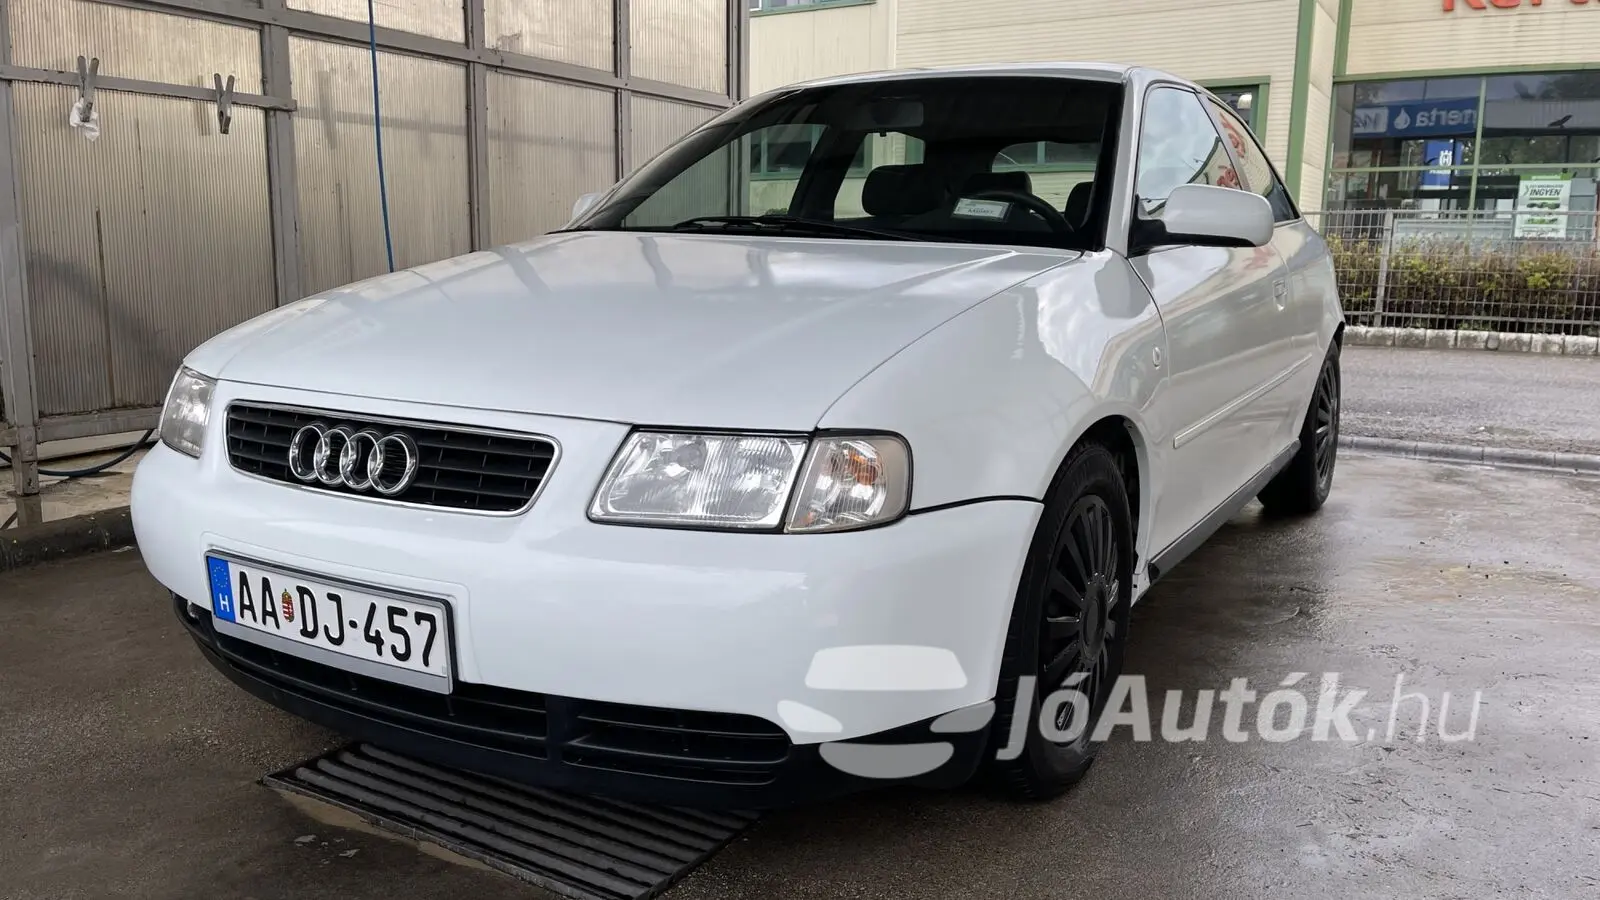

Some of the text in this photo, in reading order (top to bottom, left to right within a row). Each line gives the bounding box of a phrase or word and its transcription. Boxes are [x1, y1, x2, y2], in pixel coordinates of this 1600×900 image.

[1529, 188, 1561, 196] INGYEN
[218, 592, 230, 612] H
[239, 570, 437, 667] AA DJ-457
